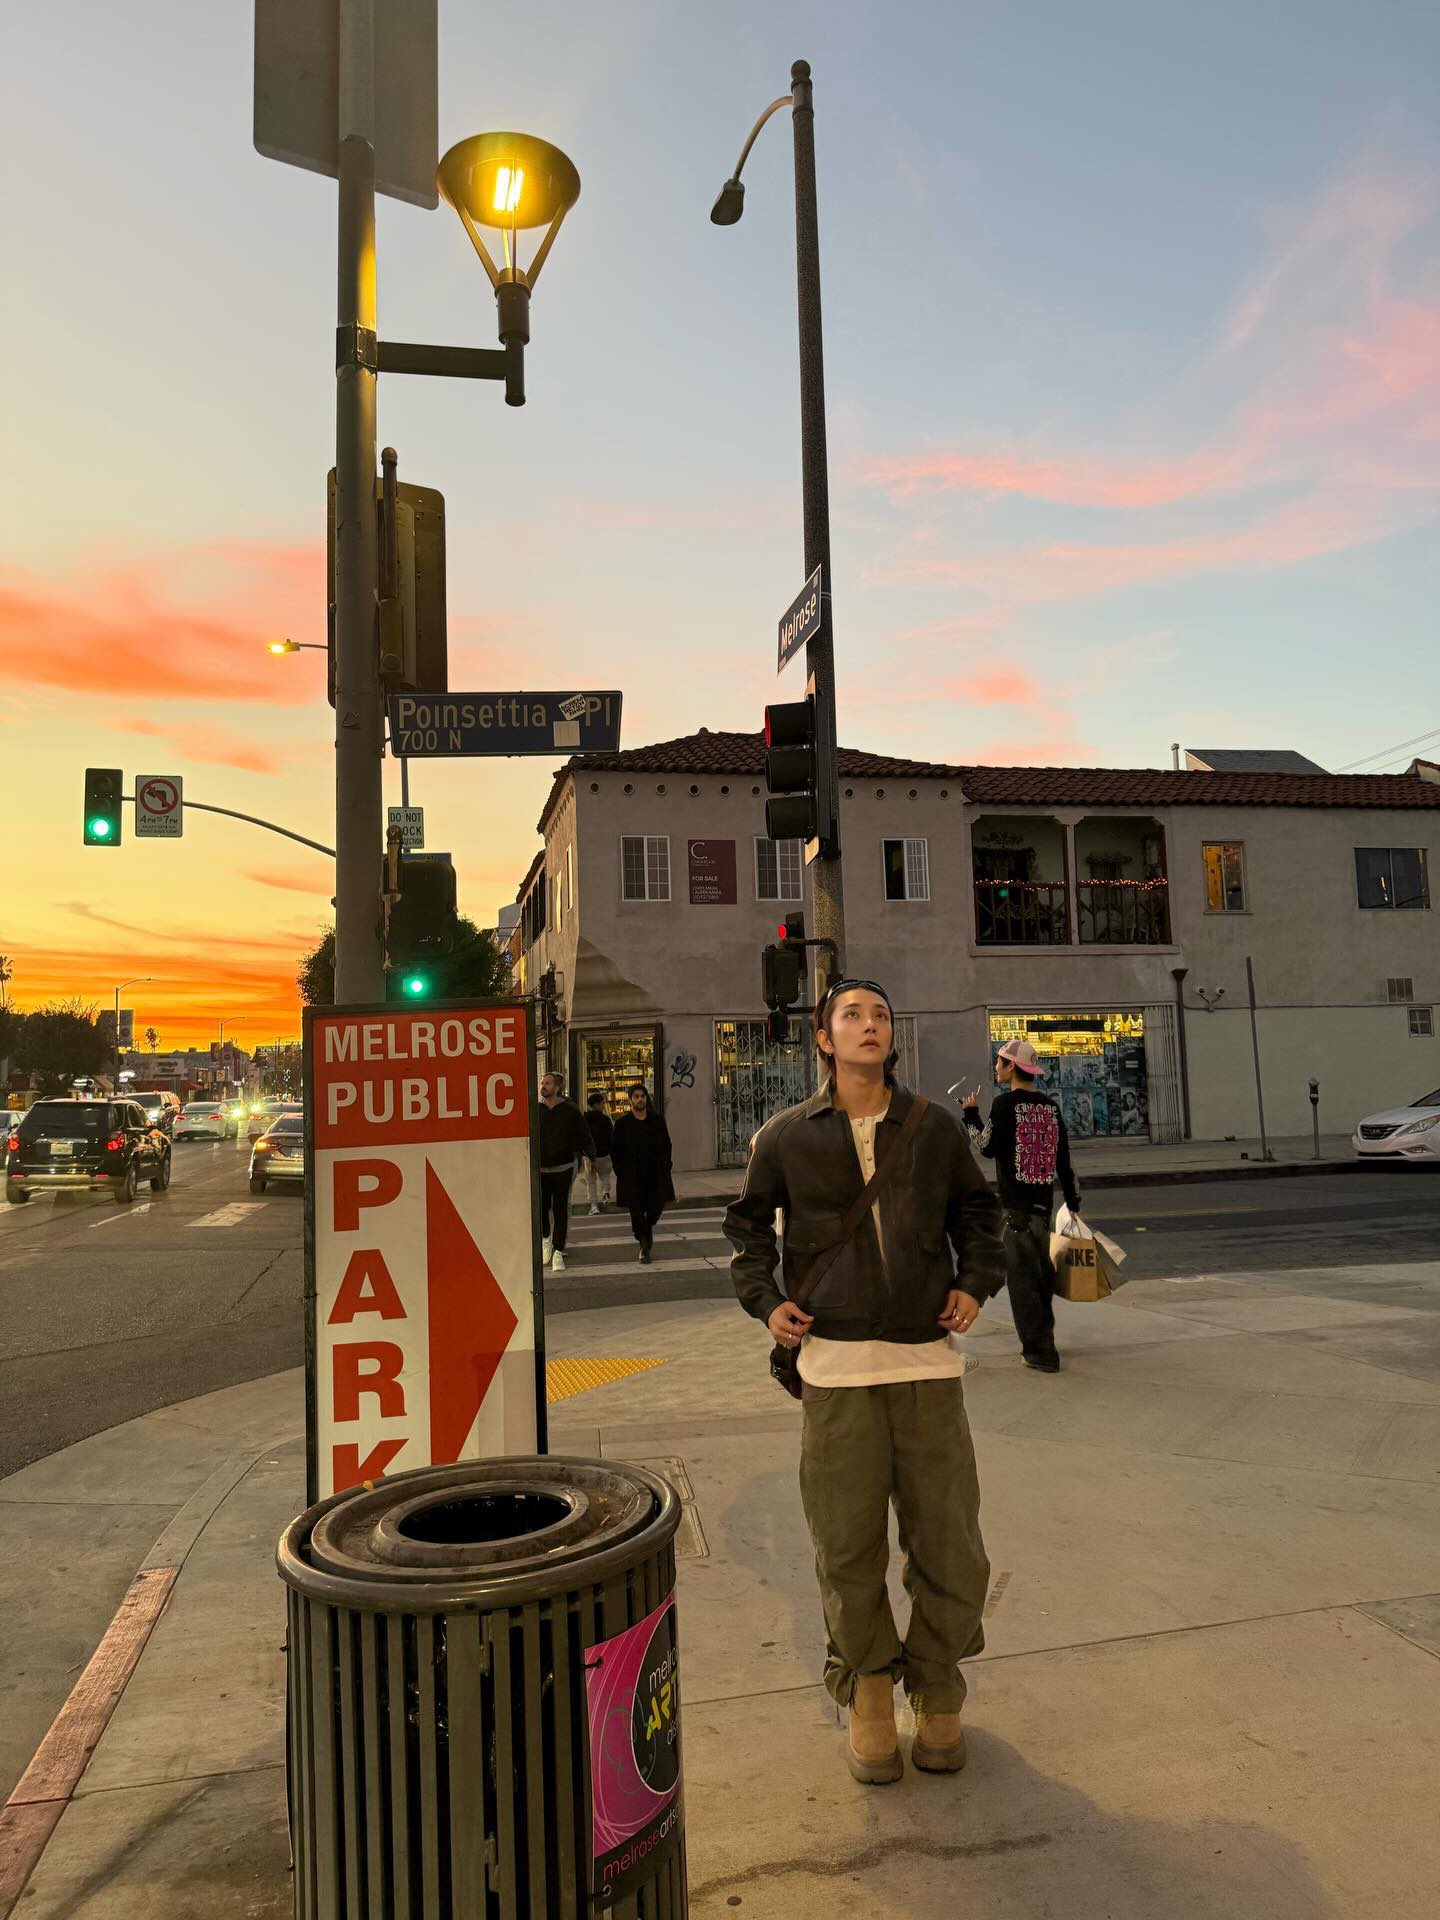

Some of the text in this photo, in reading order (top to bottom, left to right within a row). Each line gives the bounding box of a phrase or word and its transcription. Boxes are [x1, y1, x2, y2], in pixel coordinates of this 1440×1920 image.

[781, 593, 817, 656] Melrose
[399, 698, 547, 729] Poinsettia
[400, 730, 462, 750] 700 N
[390, 812, 422, 822] DO NOT
[401, 826, 422, 836] OCK
[324, 1016, 516, 1063] MELROSE
[327, 1072, 515, 1126] PUBLIC
[1015, 1113, 1059, 1125] HEARS
